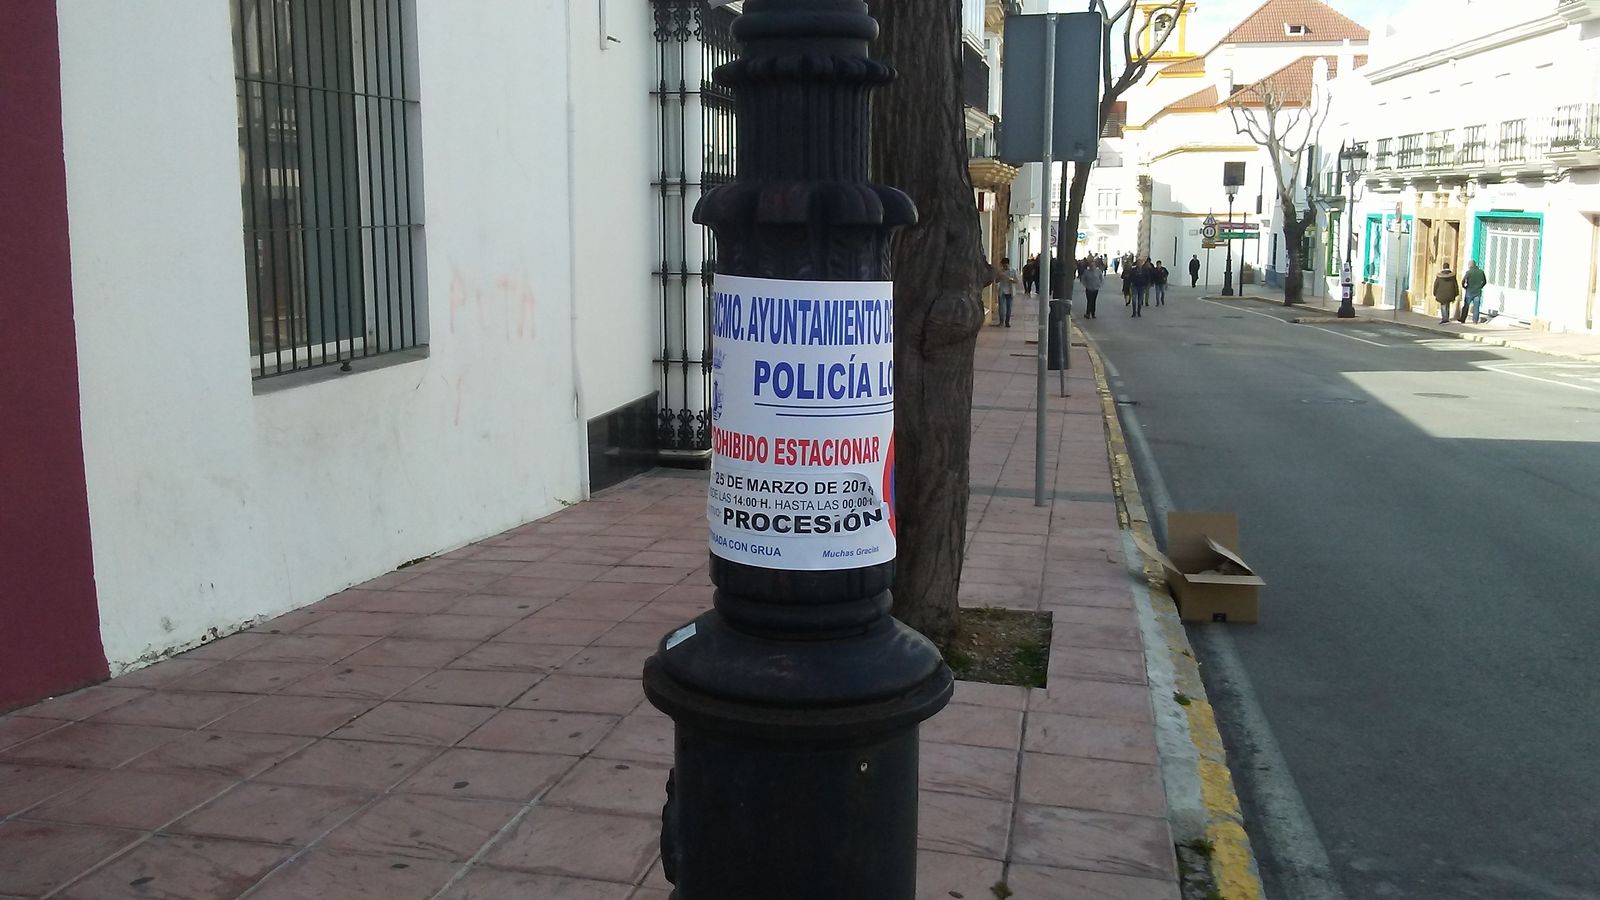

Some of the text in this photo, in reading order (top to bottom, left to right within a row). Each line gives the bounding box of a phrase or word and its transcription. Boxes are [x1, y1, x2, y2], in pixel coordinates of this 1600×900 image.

[713, 292, 744, 341] XCMO.
[747, 296, 882, 346] AYUNTAMIENTO
[753, 353, 873, 400] POLICÍA
[774, 436, 880, 467] ESTACIONAR
[715, 471, 725, 486] 25
[727, 474, 744, 490] DE
[747, 478, 809, 495] MARZO
[814, 481, 838, 495] DE
[733, 494, 757, 508] 14:00
[774, 499, 815, 511] HASTA
[817, 500, 840, 511] LAS
[723, 506, 883, 535] PROCESIÓN
[728, 539, 748, 552] CON
[750, 544, 782, 557] GRUA
[822, 546, 880, 558] Muchas Gracias
